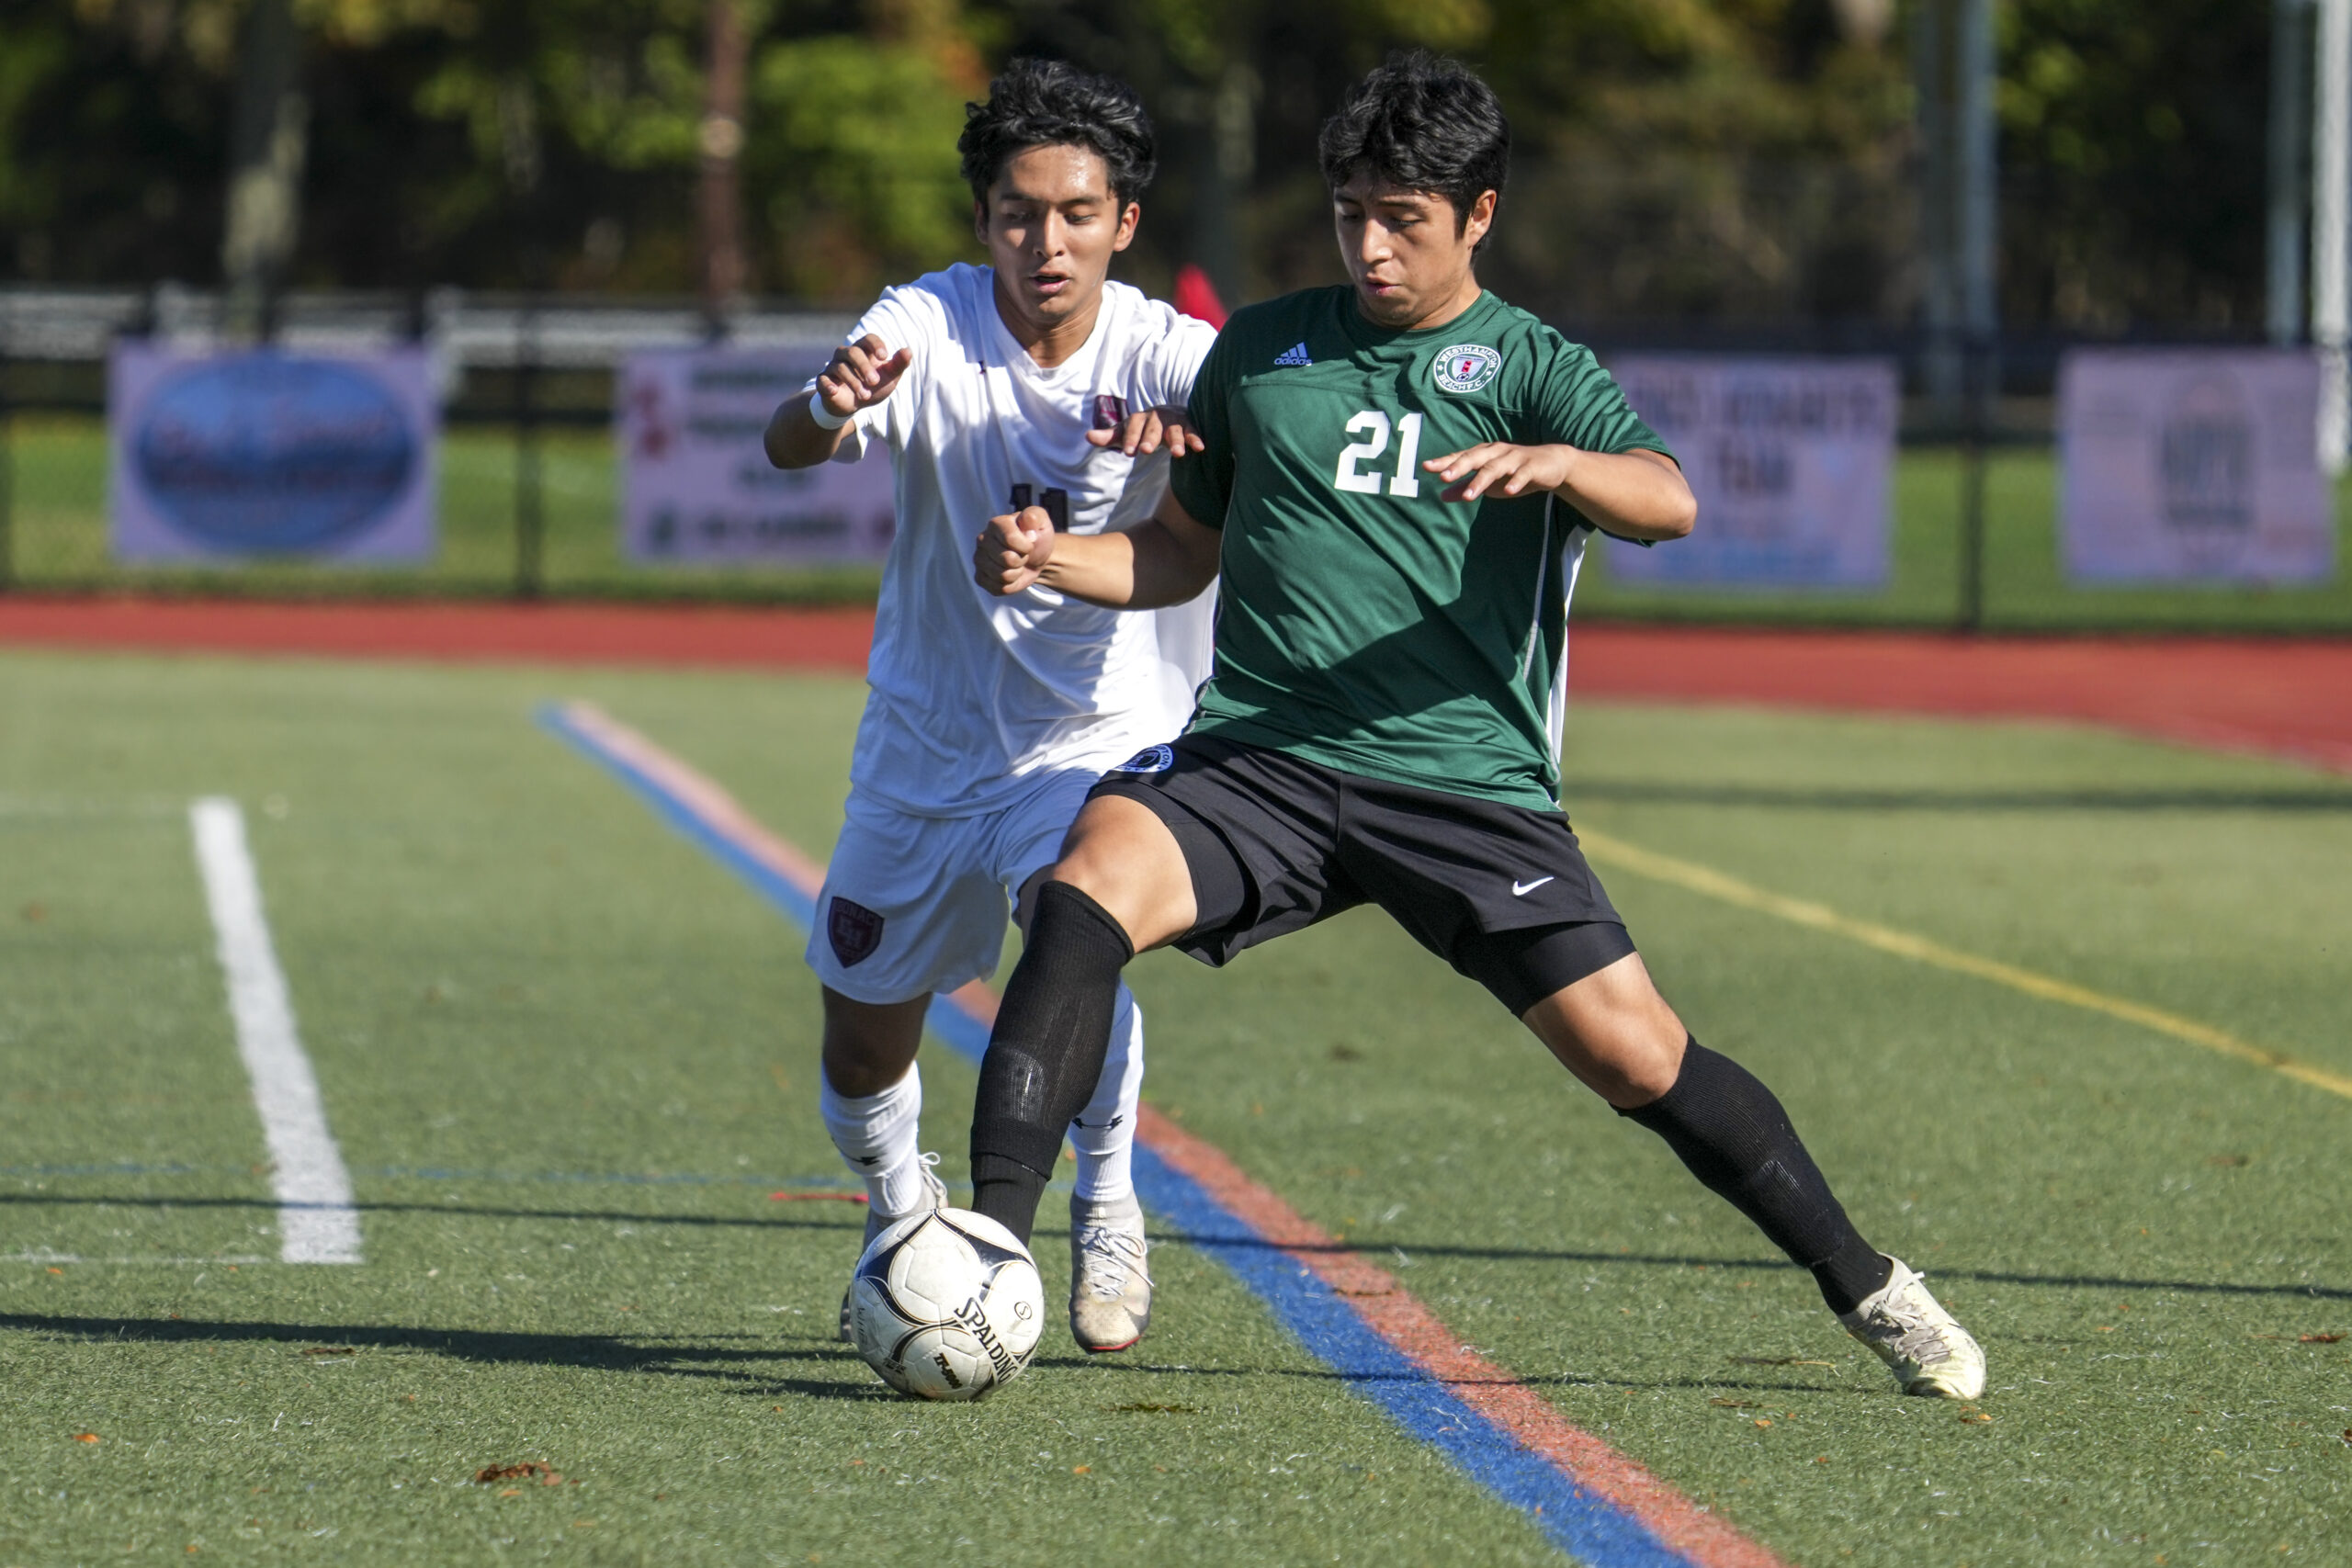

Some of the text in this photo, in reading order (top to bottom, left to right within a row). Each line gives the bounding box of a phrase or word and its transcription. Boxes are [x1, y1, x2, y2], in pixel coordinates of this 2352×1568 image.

[1274, 356, 1313, 367] adidas
[1439, 346, 1498, 368] WESTHAMPTON
[1439, 373, 1466, 390] BEACH
[1335, 411, 1422, 498] 21
[954, 1296, 1019, 1384] SPALDING
